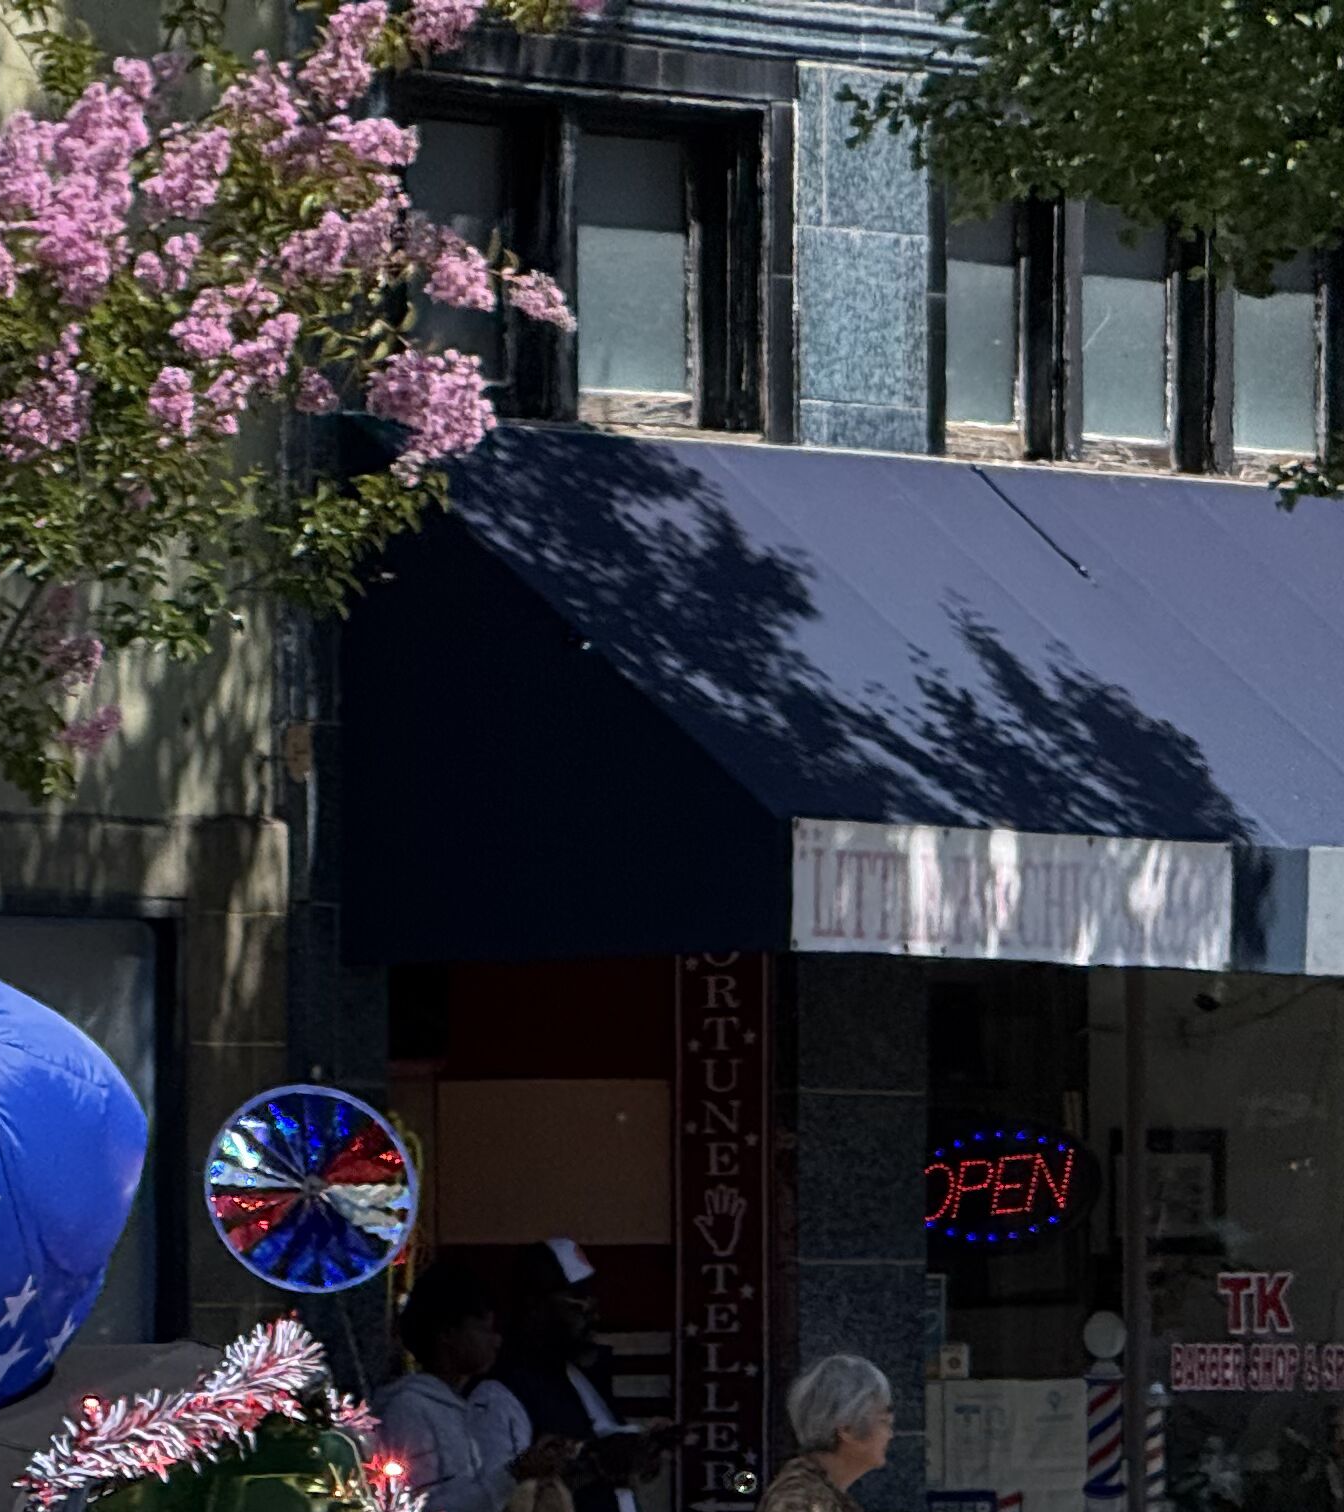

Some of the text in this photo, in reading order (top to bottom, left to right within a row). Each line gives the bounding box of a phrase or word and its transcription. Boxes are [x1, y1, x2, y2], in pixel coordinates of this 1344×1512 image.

[924, 1148, 1075, 1222] OPEN
[1217, 1271, 1294, 1335] TK
[1171, 1342, 1246, 1391] BARBER
[1248, 1342, 1300, 1392] SHOP
[1303, 1344, 1319, 1392] &
